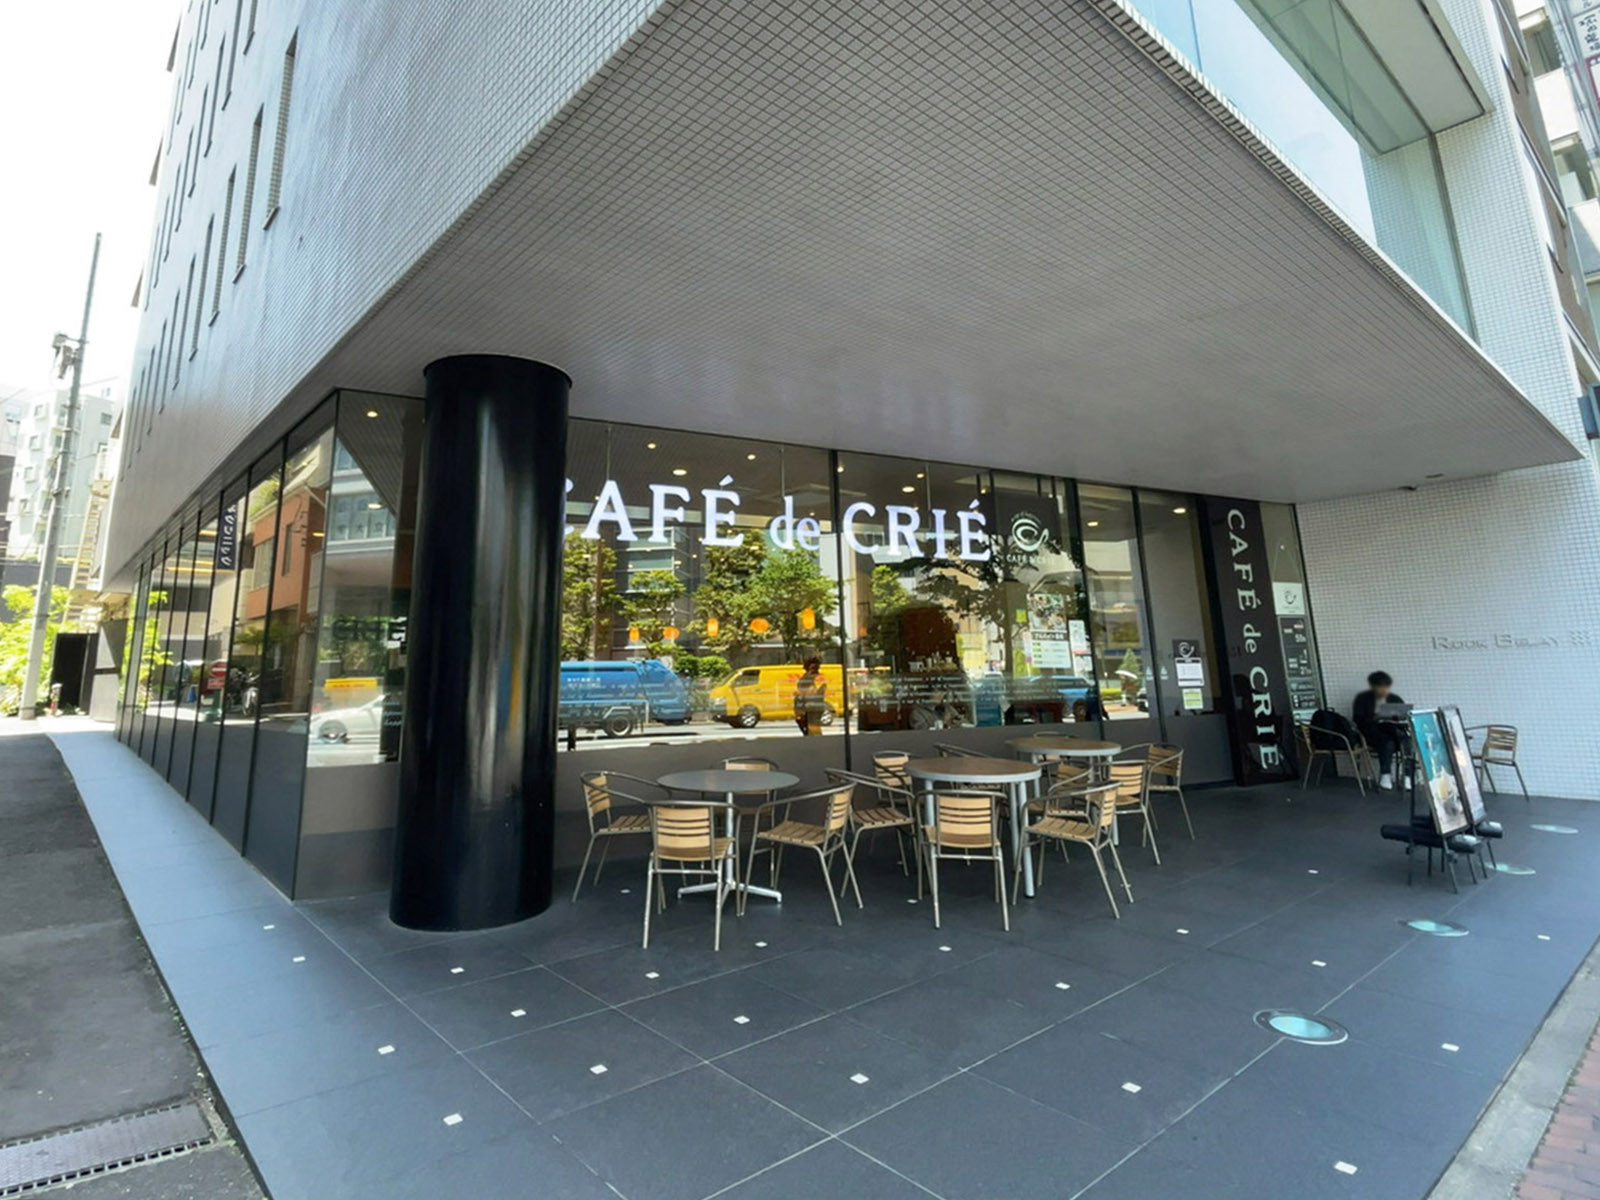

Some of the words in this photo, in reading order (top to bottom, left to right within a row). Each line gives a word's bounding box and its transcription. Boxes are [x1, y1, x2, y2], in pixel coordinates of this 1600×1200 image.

[769, 495, 821, 551] de
[842, 498, 992, 562] CRIÉ
[1227, 508, 1263, 612] CAFÉ
[1243, 623, 1262, 654] de
[1249, 665, 1285, 770] CRIÉ
